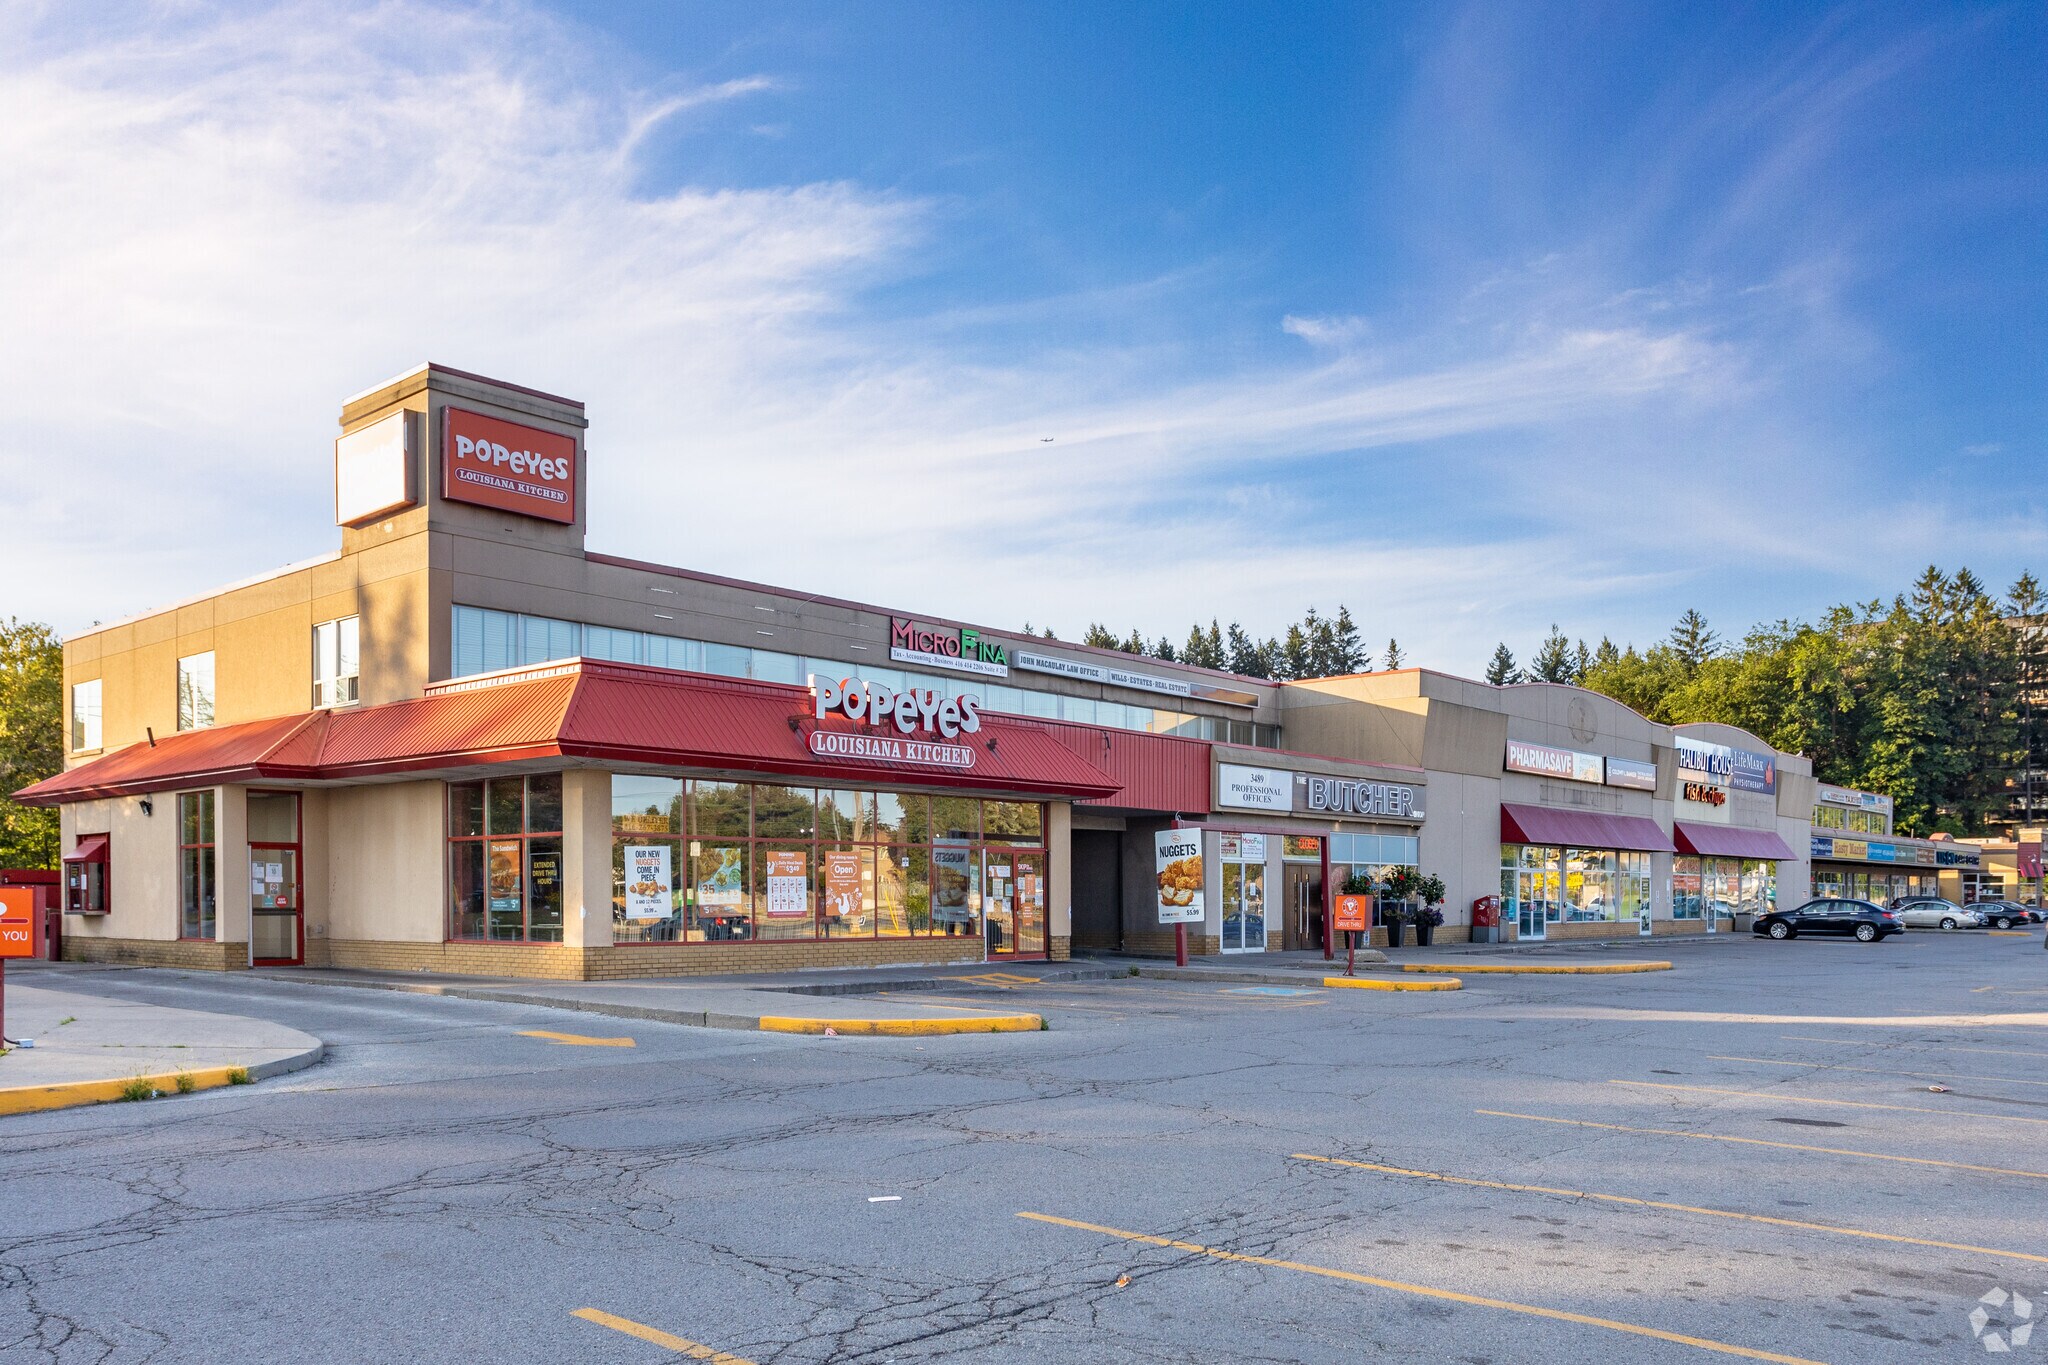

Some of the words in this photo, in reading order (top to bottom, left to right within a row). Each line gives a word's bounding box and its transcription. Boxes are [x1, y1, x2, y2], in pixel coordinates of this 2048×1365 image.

[460, 470, 514, 490] LOUISIANA
[518, 483, 564, 500] KITCHEN
[905, 651, 932, 663] Accounting
[934, 656, 953, 666] Business
[984, 664, 995, 673] Suite
[1020, 656, 1035, 666] JOHN
[1036, 659, 1065, 671] MACAULAY
[1066, 664, 1079, 674] LAW
[1080, 665, 1100, 678] OFFICE
[1111, 673, 1128, 683] WILLS
[1129, 676, 1153, 688] ESTATES
[1154, 680, 1168, 690] REAL
[1168, 682, 1188, 694] ESTATE
[816, 733, 902, 758] LOUISIANA
[906, 742, 971, 765] KITCHEN
[1510, 745, 1572, 774] PHARMASAVE
[1680, 748, 1709, 772] HALIBUT
[1711, 755, 1734, 776] HOUSE
[1250, 773, 1265, 784] 3489
[1296, 775, 1307, 785] THE
[1734, 778, 1764, 790] PHYSIOTHERAPY
[1231, 784, 1282, 796] PROFESSIONAL
[1243, 793, 1272, 803] OFFICES
[1308, 778, 1414, 817] BUTCHER
[635, 850, 646, 858] OUR
[648, 850, 660, 858] NEW
[1159, 844, 1197, 858] NUGGETS
[635, 858, 660, 866] NUGGETS
[637, 866, 652, 874] COME
[654, 866, 660, 874] IN
[834, 865, 854, 875] Open
[641, 874, 656, 882] PIECE
[2, 930, 28, 941] YOU
